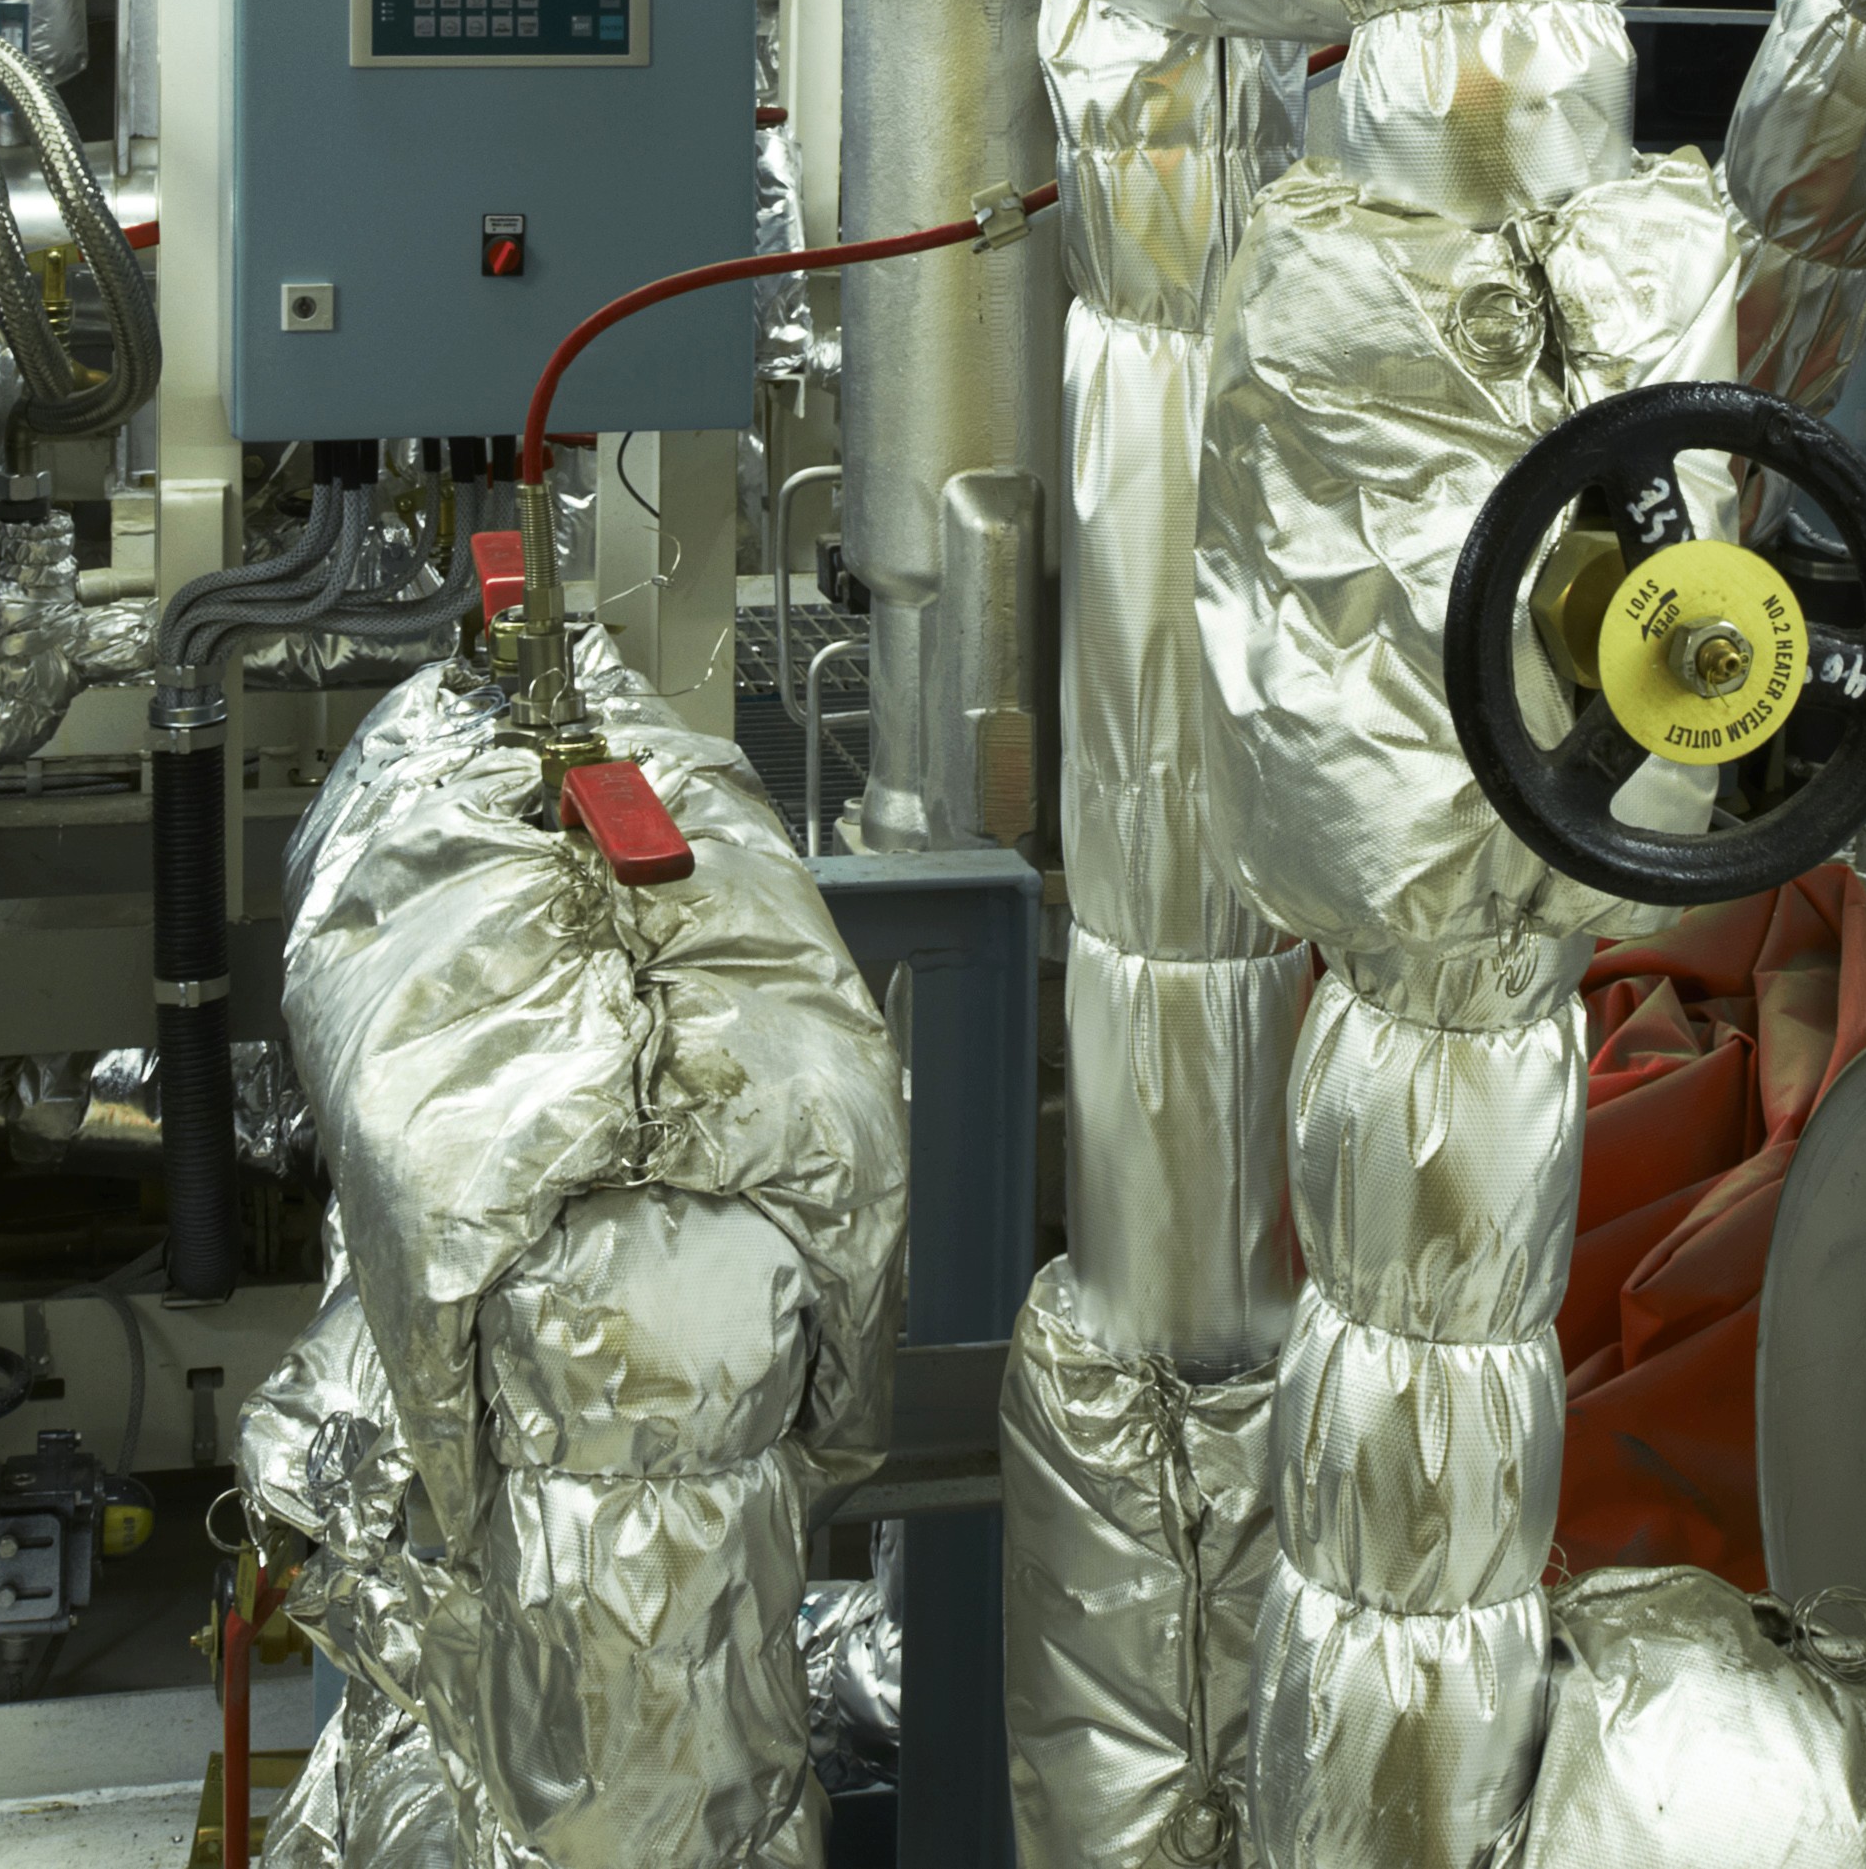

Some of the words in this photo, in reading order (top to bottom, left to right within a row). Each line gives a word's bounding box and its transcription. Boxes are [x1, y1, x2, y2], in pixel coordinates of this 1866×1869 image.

[1626, 579, 1660, 620] SV07
[1762, 594, 1791, 635] NO.2
[1650, 604, 1680, 639] OPEN
[1765, 640, 1793, 701] HEATER
[1664, 724, 1722, 749] OUTLET
[1726, 700, 1773, 742] STEAM
